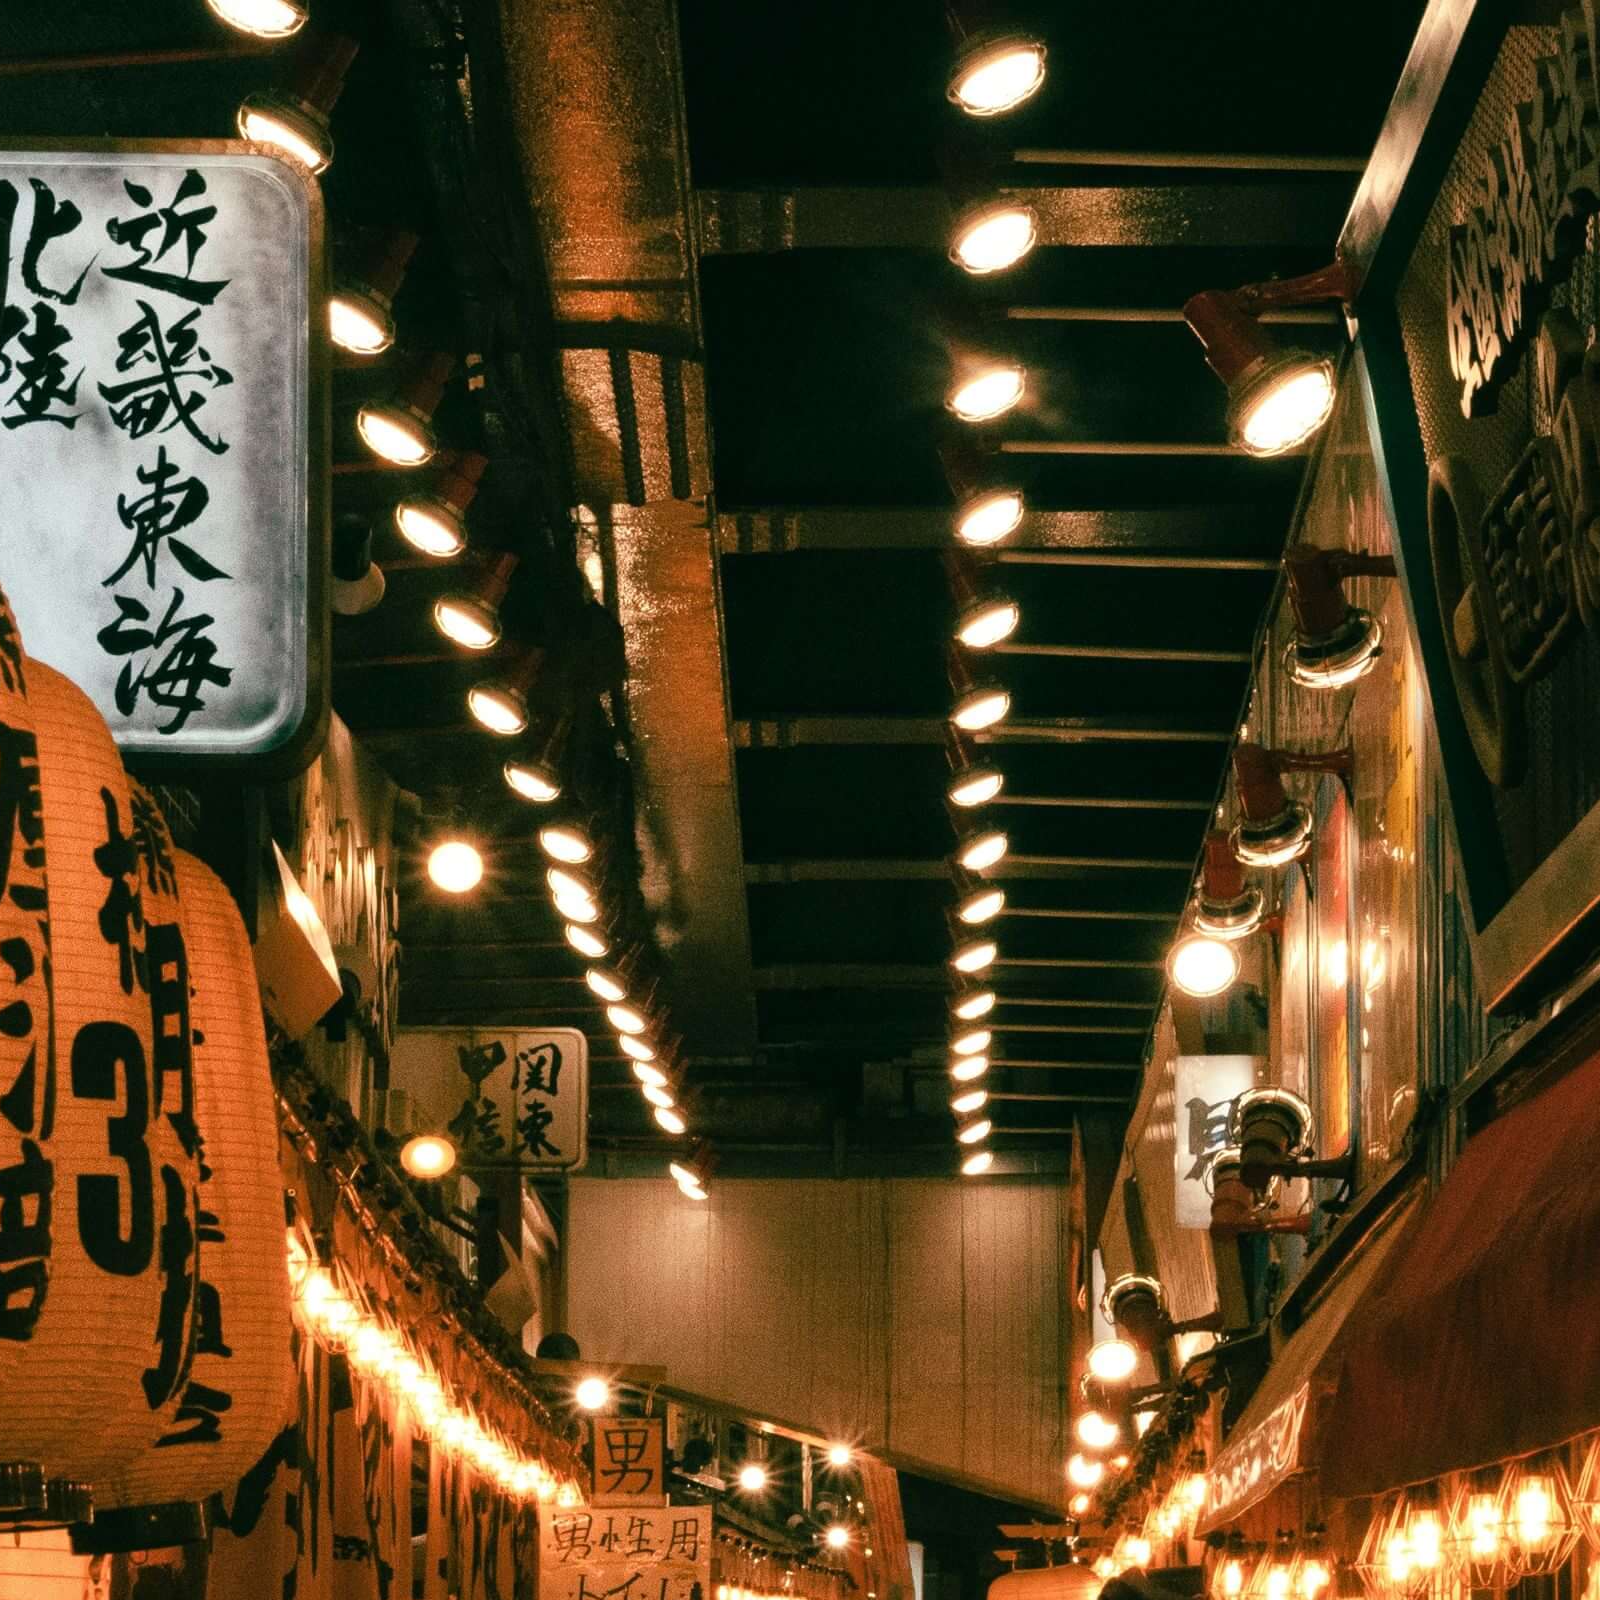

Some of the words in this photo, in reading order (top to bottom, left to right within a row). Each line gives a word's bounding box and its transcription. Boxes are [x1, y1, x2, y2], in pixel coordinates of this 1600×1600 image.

[94, 168, 234, 735] 近畿東海
[447, 1040, 507, 1154] 甲信
[510, 1042, 562, 1158] 関東
[600, 1428, 655, 1496] 男
[551, 1513, 701, 1563] 男性用
